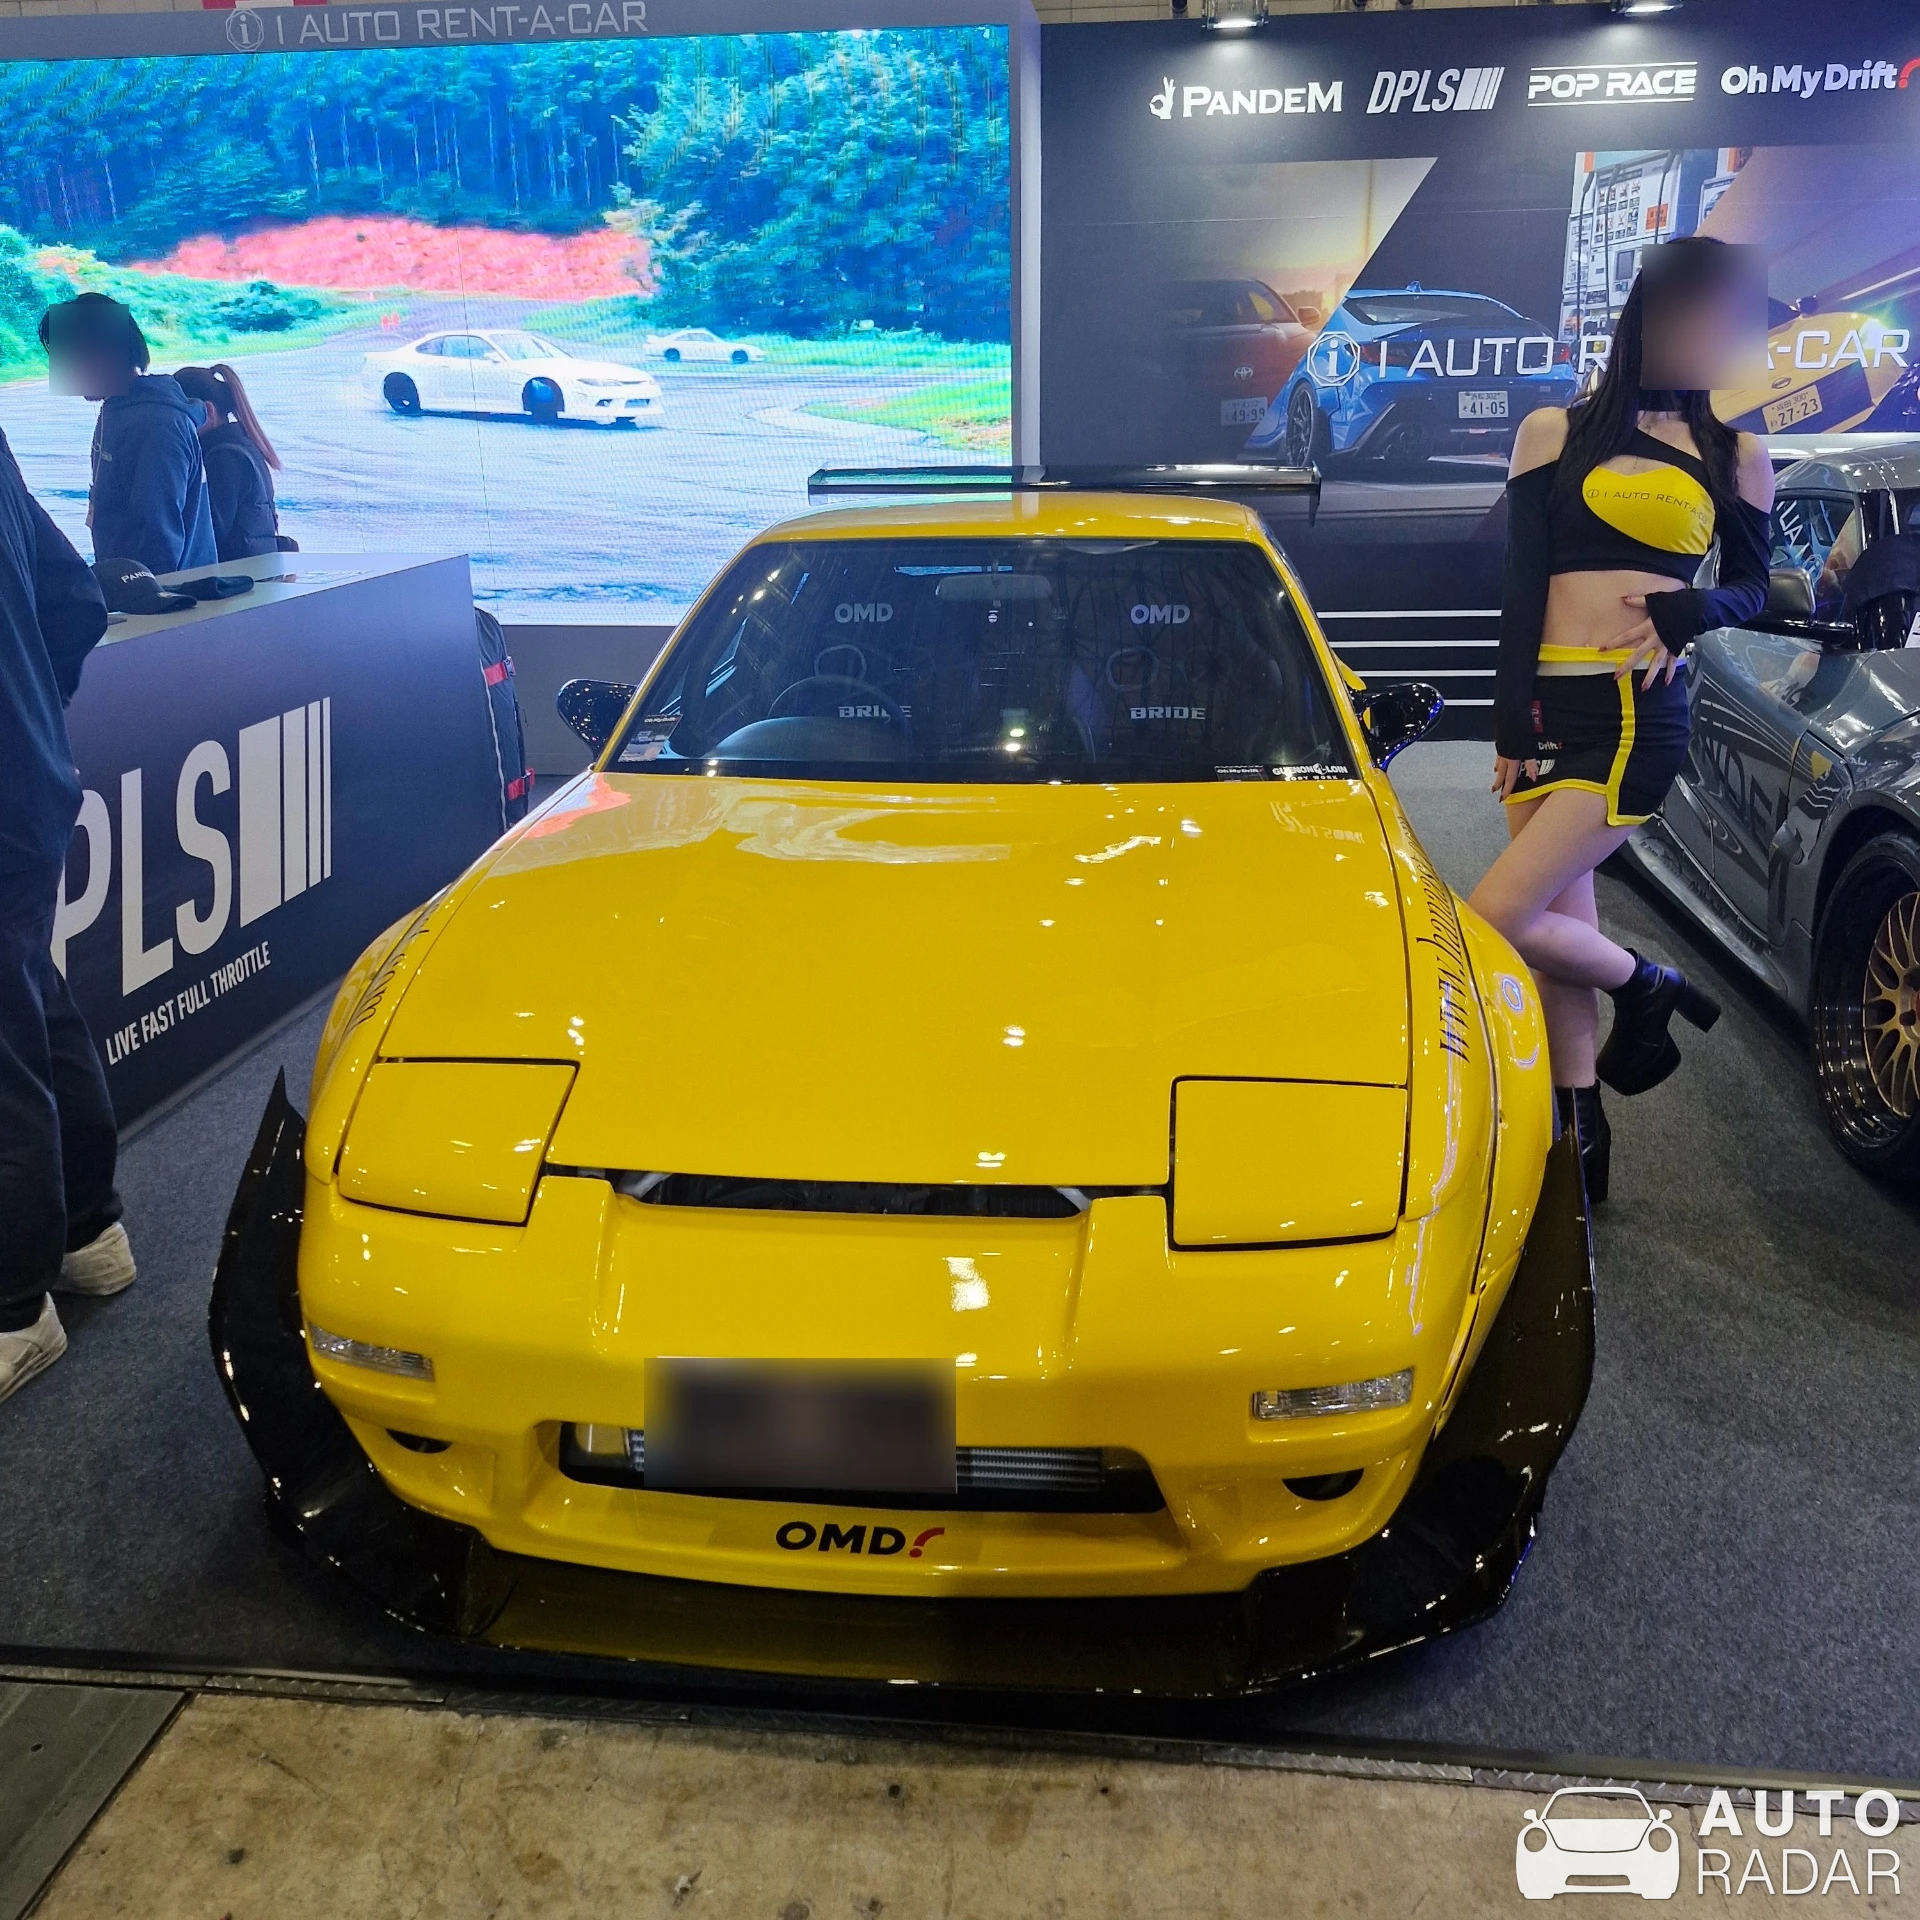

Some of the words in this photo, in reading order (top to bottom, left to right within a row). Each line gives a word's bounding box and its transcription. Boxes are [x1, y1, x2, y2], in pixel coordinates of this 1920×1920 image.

[299, 11, 400, 44] AUTO
[416, 1, 649, 40] RENT-A-CAR
[1366, 68, 1461, 114] DPLS
[1528, 73, 1599, 100] POP
[1605, 69, 1697, 97] RACE
[1720, 65, 1768, 95] Oh
[1771, 65, 1817, 99] My
[1823, 60, 1898, 92] Drift
[1182, 81, 1343, 118] PANDEM
[1406, 336, 1554, 378] AUTO
[1470, 401, 1506, 415] 41-05
[1778, 398, 1818, 427] 27-23
[1613, 492, 1650, 500] AUTO
[834, 603, 894, 623] OMD
[1130, 603, 1191, 625] OMD
[1129, 706, 1206, 720] BRIDE
[50, 740, 232, 997] PLS
[106, 1022, 140, 1066] LIVE
[141, 999, 175, 1043] FAST
[177, 980, 211, 1020] FULL
[210, 941, 271, 998] THROTTLE
[776, 1521, 907, 1555] OMD
